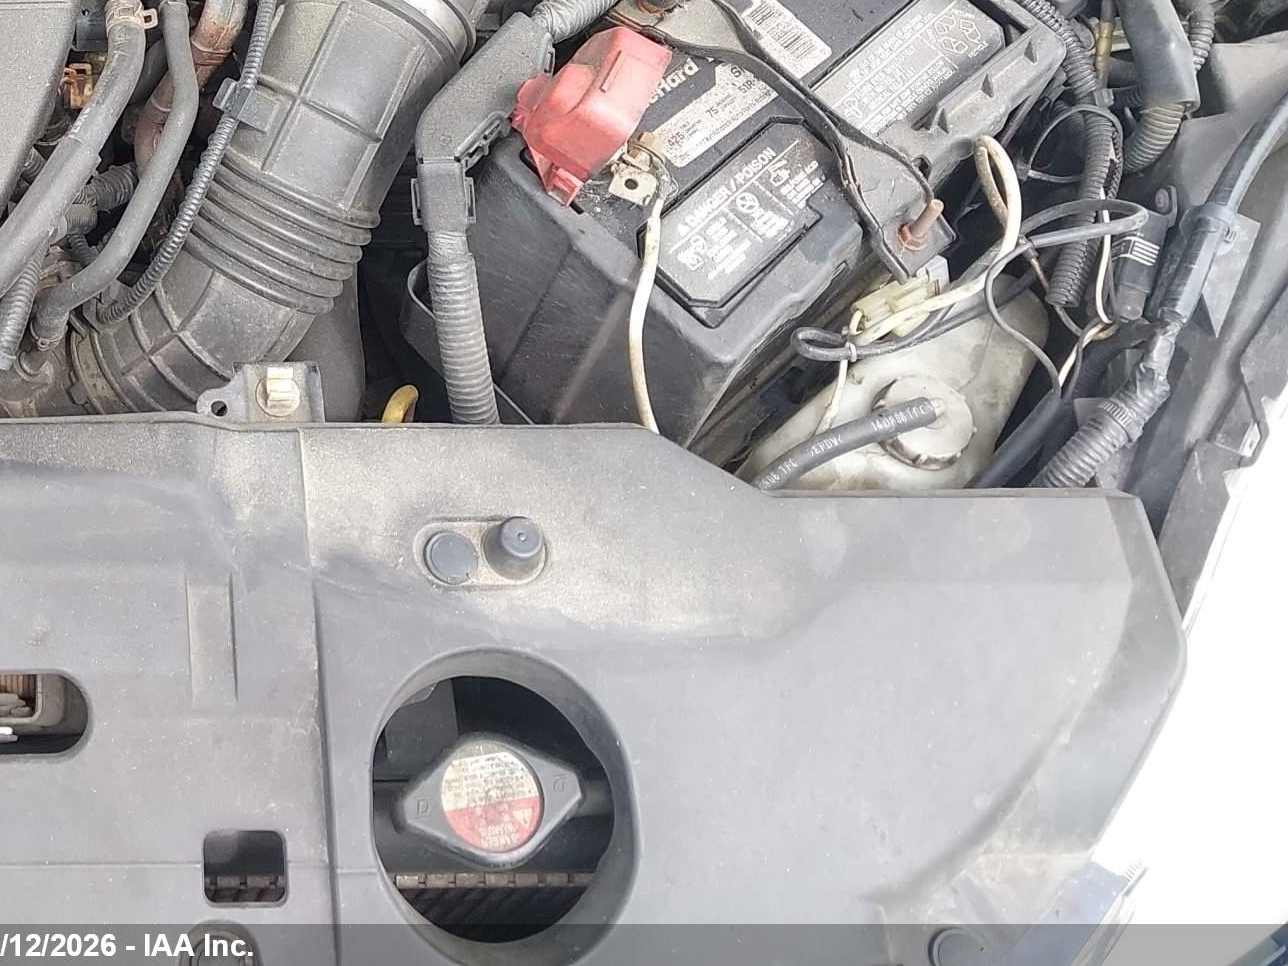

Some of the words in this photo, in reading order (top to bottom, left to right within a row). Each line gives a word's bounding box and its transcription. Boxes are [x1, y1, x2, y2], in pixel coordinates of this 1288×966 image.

[705, 106, 720, 118] 75
[667, 131, 685, 148] 425
[685, 188, 732, 227] DANGER
[735, 147, 777, 185] POISON
